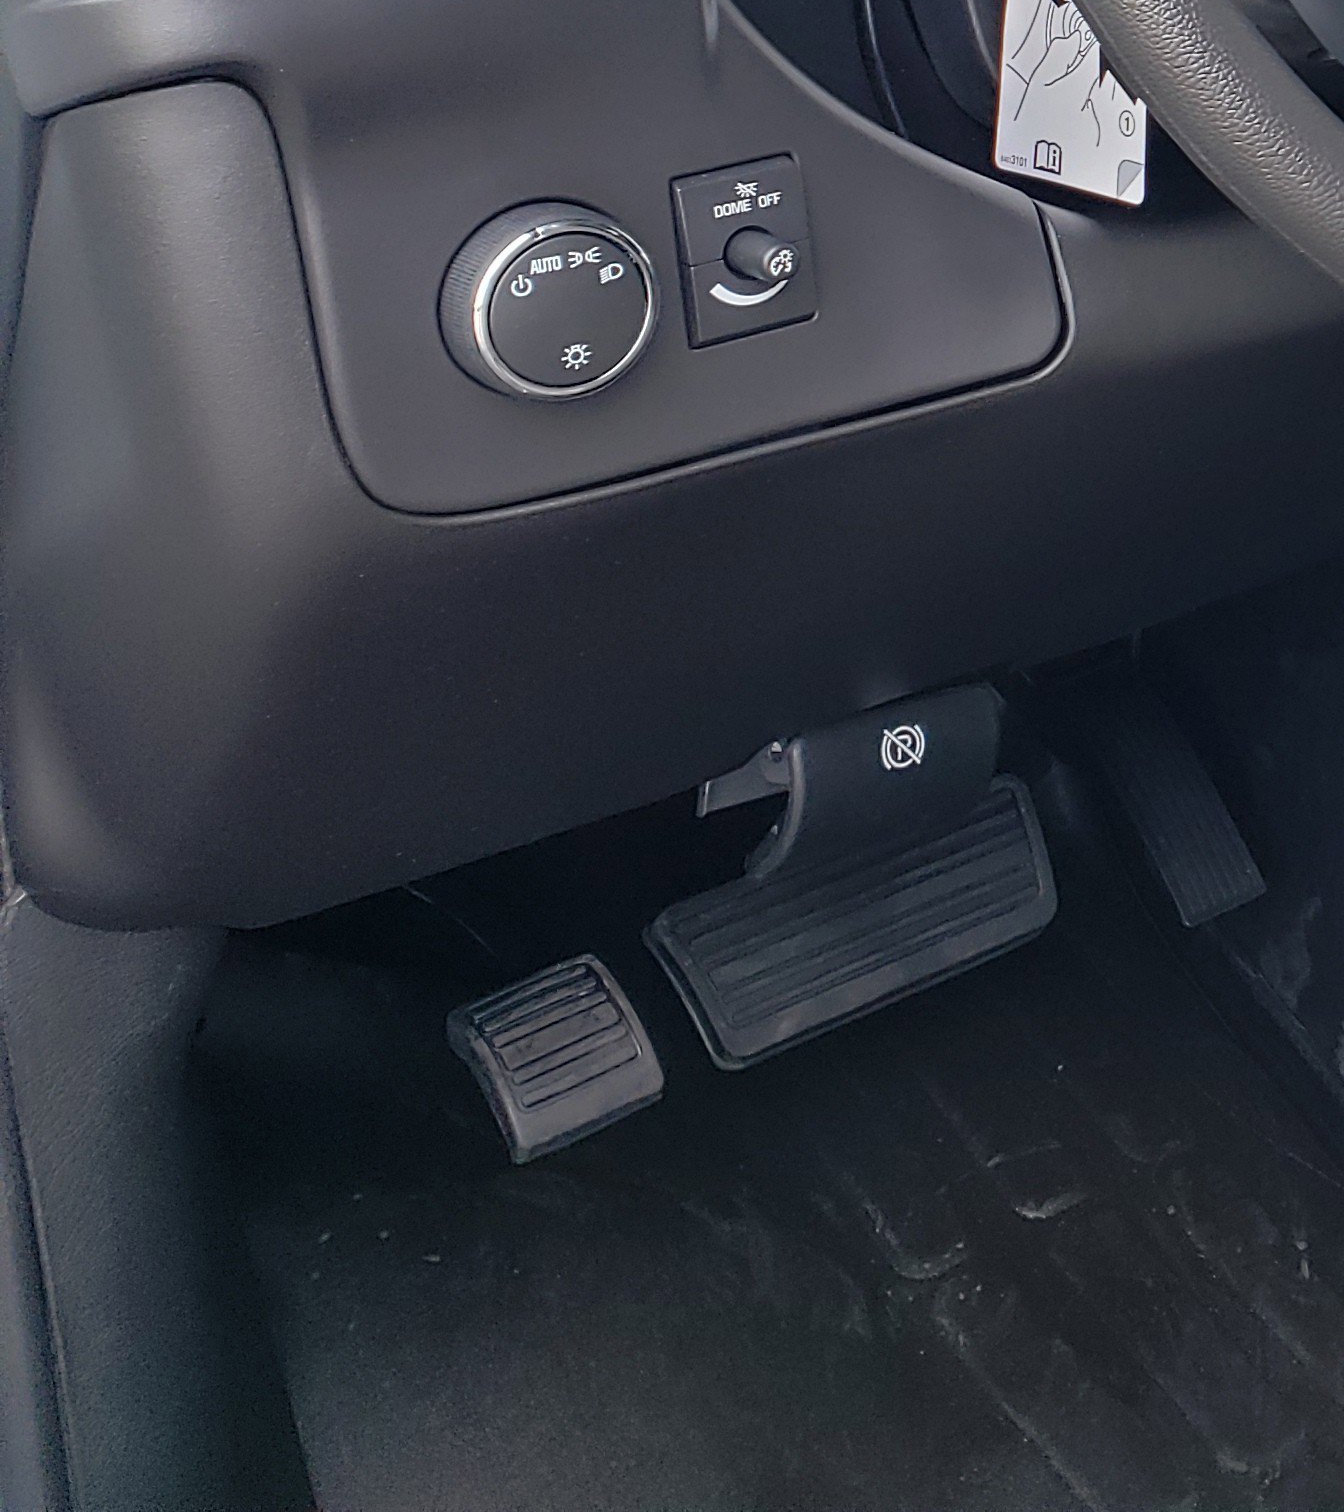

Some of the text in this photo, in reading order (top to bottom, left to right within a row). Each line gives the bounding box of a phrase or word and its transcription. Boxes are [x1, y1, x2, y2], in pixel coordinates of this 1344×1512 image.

[713, 191, 782, 219] DOME OFF
[530, 255, 562, 276] AUTO
